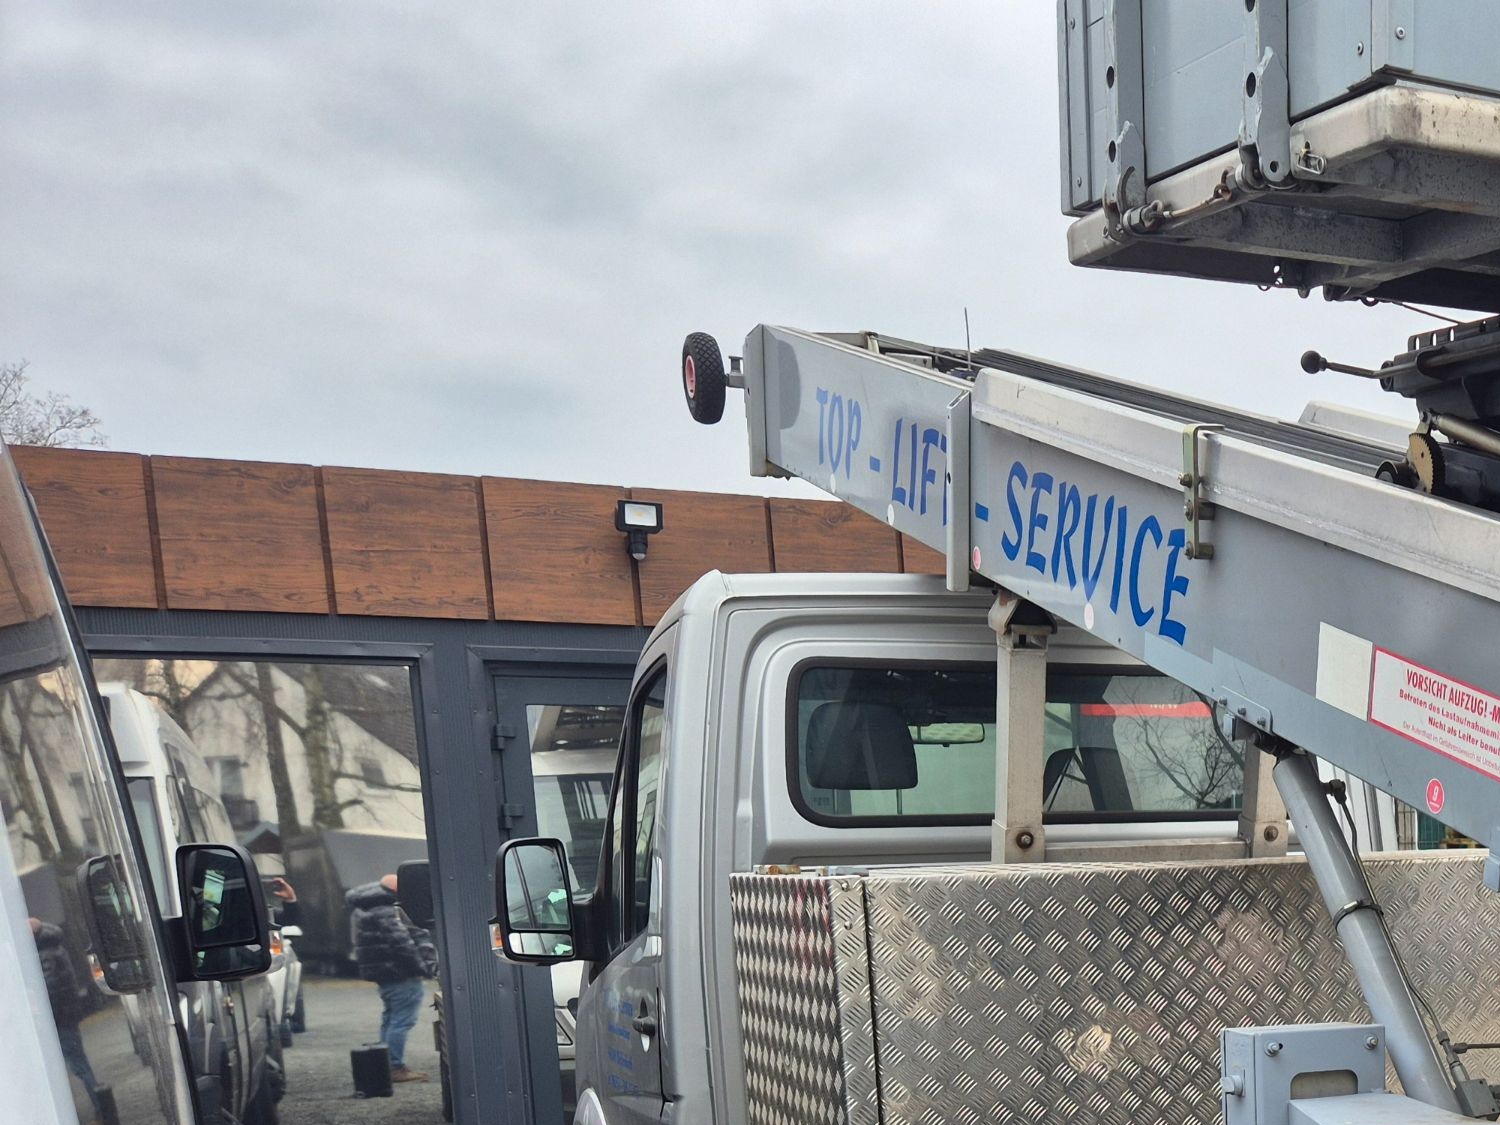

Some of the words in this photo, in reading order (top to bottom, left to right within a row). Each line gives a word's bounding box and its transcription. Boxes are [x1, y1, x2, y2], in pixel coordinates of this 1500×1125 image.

[816, 387, 862, 480] TOP
[1001, 461, 1191, 647] SERVICE
[1400, 689, 1427, 708] Betreten
[1429, 703, 1440, 715] des
[1407, 669, 1447, 700] VORSICHT
[1448, 687, 1488, 718] AUFZUG!
[1428, 716, 1446, 732] Nicht
[1447, 726, 1457, 737] als
[1458, 730, 1479, 746] Leiter
